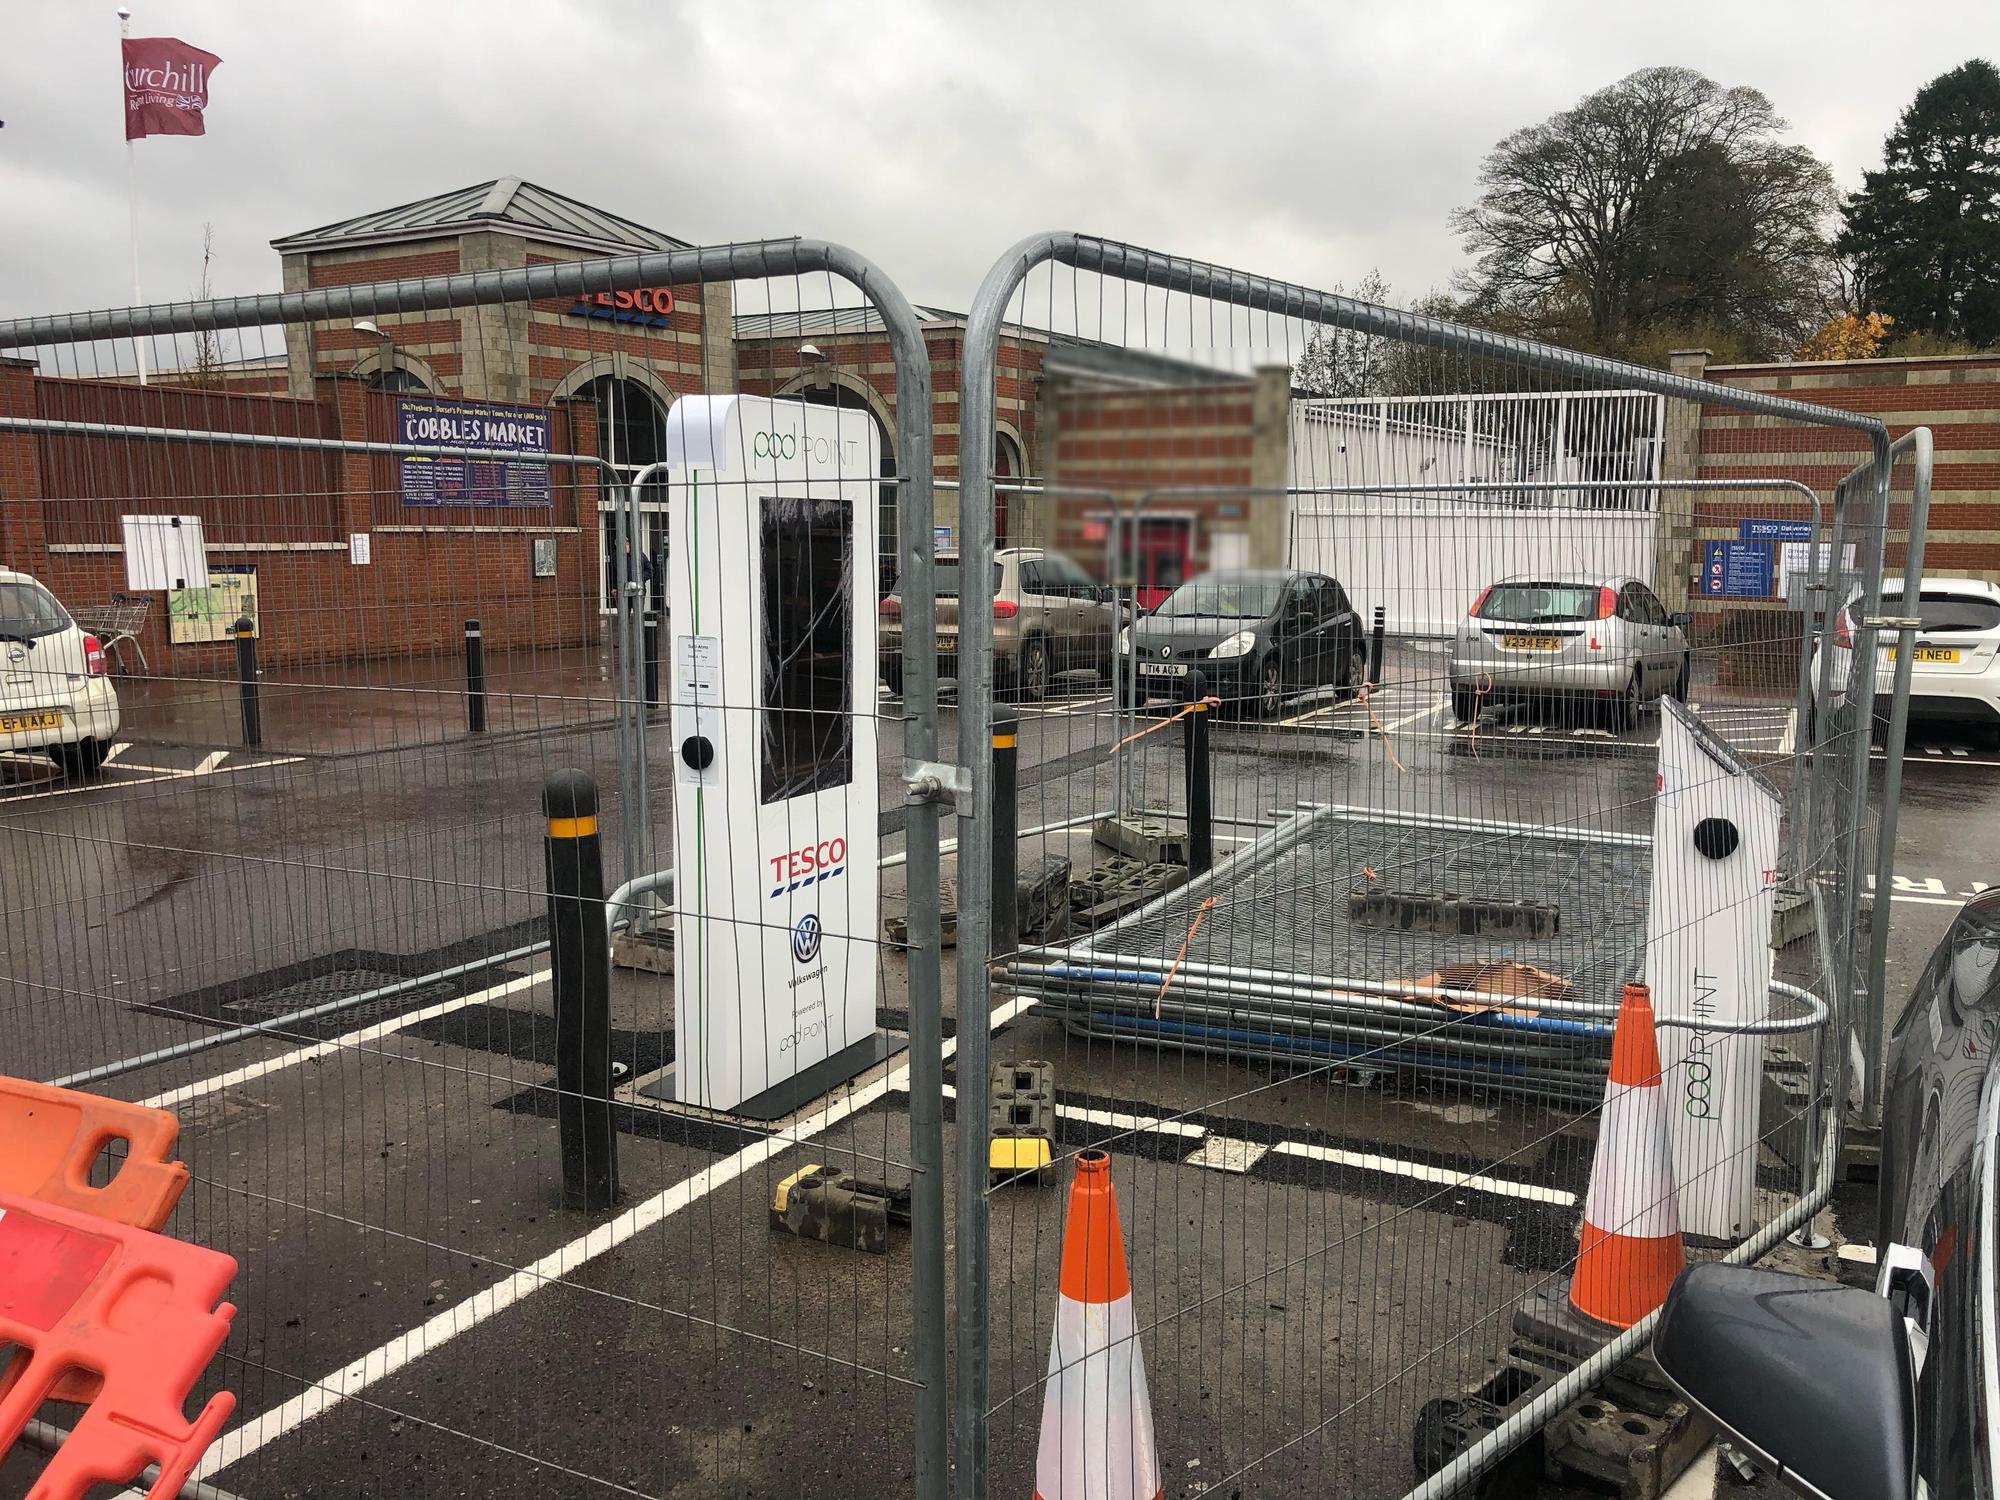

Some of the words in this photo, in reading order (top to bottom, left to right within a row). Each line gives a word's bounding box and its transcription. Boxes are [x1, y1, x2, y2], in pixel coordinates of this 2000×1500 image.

[145, 93, 174, 108] Living
[406, 417, 480, 441] COBBLES
[484, 421, 544, 446] MARKET
[754, 421, 796, 470] pod
[801, 436, 858, 466] POINT
[1926, 650, 1952, 660] NEO
[770, 837, 846, 883] TESCO
[788, 965, 828, 989] Volkswagen
[791, 1001, 816, 1019] Powered
[816, 1000, 823, 1008] by
[780, 1024, 802, 1058] pod
[803, 1014, 834, 1041] POINT
[1682, 1061, 1720, 1119] pod
